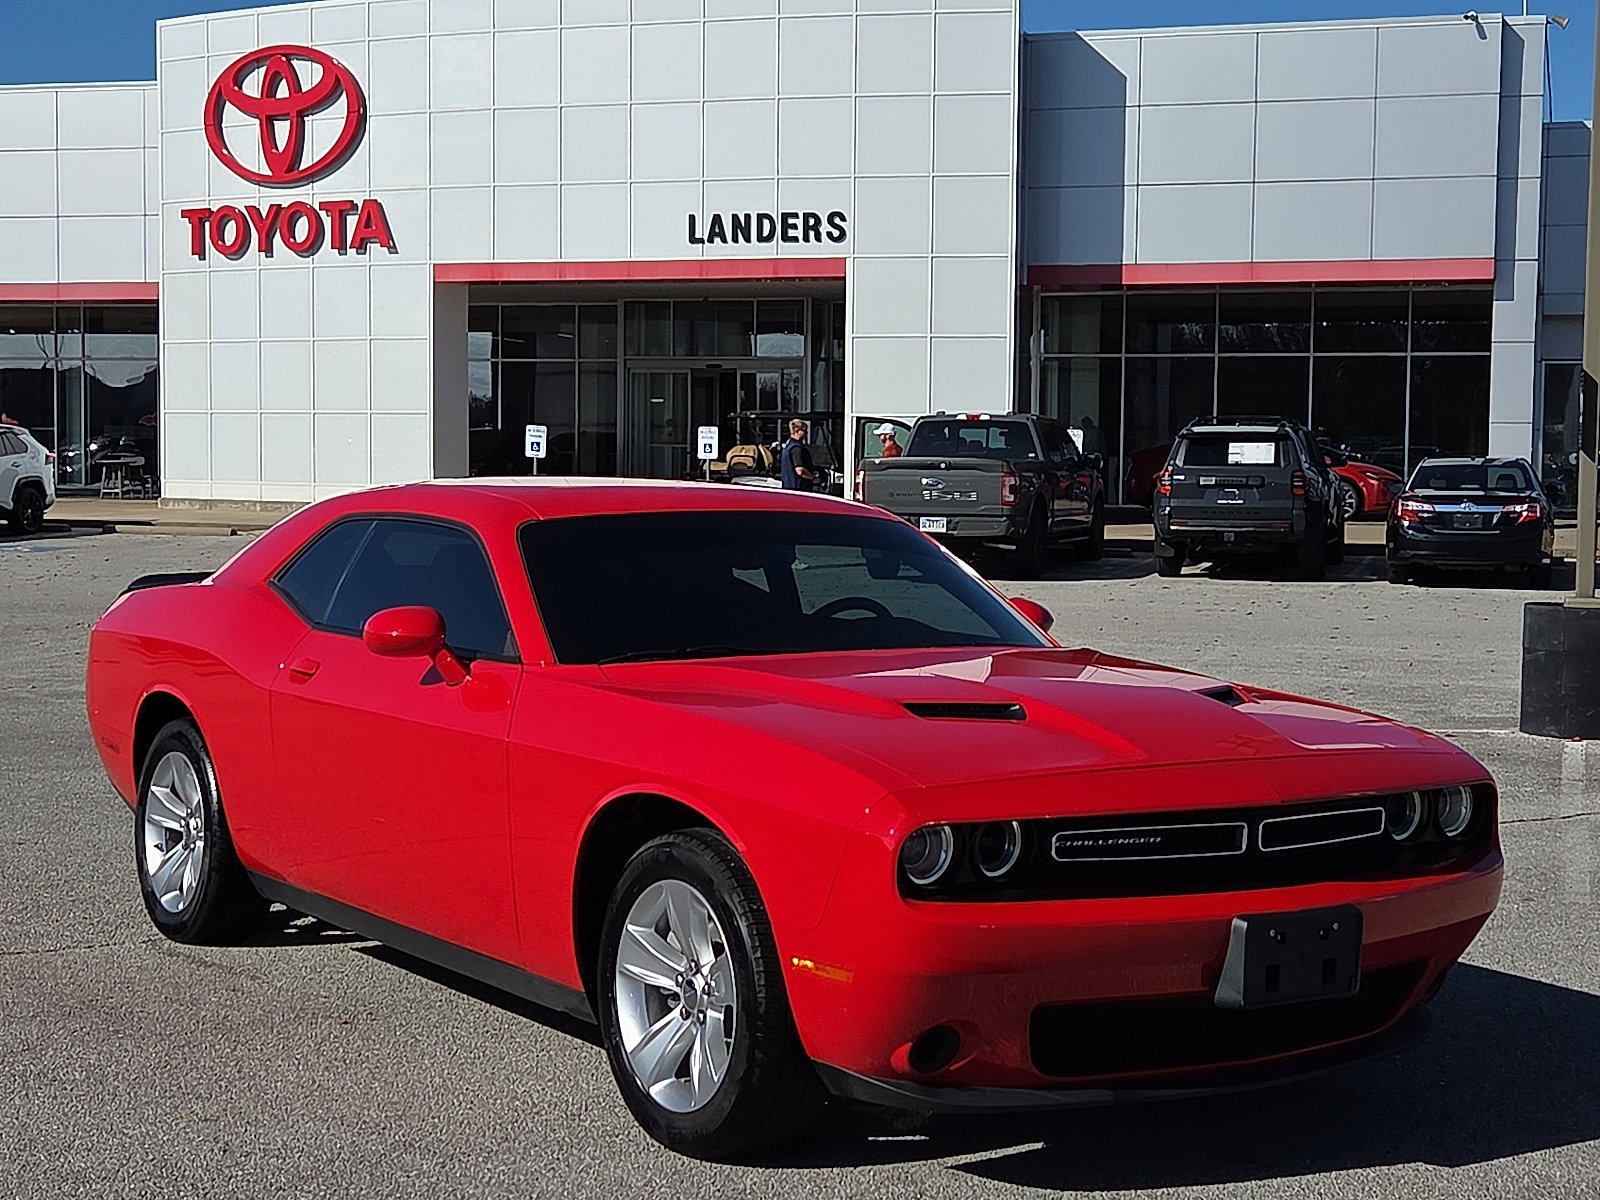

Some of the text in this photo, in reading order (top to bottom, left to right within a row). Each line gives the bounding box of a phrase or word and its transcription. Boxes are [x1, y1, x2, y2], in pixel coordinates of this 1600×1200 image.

[181, 199, 398, 260] TOYOTA
[688, 211, 848, 245] LANDERS
[1054, 836, 1162, 848] CHALLENGER
